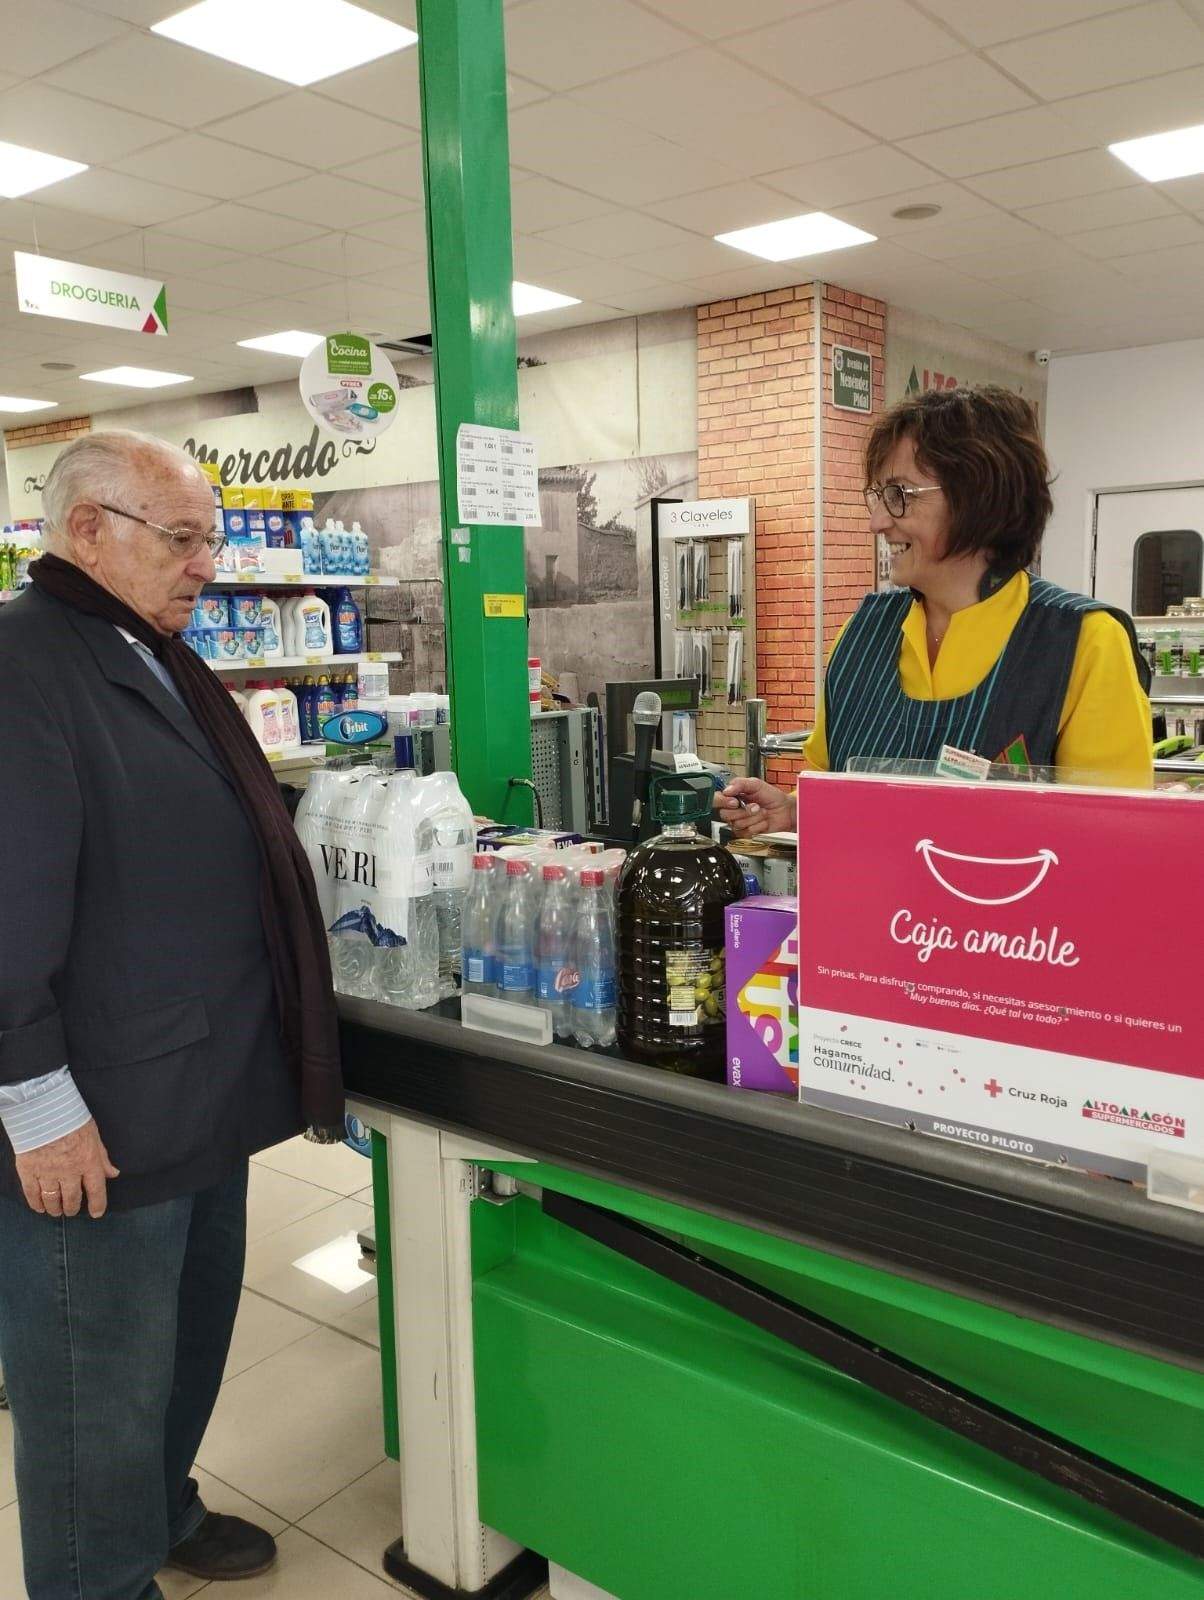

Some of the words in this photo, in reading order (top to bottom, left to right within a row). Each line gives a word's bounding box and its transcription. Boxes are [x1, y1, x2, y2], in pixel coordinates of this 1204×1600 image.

[50, 280, 141, 311] DROGUERIA
[331, 345, 368, 357] Cocina
[183, 424, 339, 486] Mercado
[671, 512, 677, 523] 3
[680, 509, 733, 523] Claveles
[318, 843, 377, 888] VERI
[890, 909, 958, 963] Caja
[963, 926, 1080, 967] amable
[817, 965, 830, 976] Sin
[831, 968, 857, 981] prisas.
[859, 972, 878, 984] Para
[917, 983, 971, 1000] comprando,
[973, 990, 981, 1000] si
[982, 992, 1026, 1008] necesitas
[1104, 1013, 1111, 1022] o
[1113, 1013, 1123, 1024] si
[1125, 1016, 1166, 1031] quieres
[1168, 1023, 1183, 1033] un
[929, 995, 960, 1009] buenos
[961, 1000, 982, 1013] días.
[984, 1004, 1007, 1016] ¿Qué
[1008, 1009, 1021, 1019] tal
[1022, 1012, 1034, 1022] va
[814, 1045, 863, 1062] Hagamos
[840, 1039, 862, 1049] CRECE
[732, 1057, 742, 1087] evax
[813, 1056, 895, 1082] comunidad.
[1008, 1087, 1037, 1101] Cruz
[1040, 1093, 1068, 1109] Roja
[1082, 1099, 1186, 1128] ALTOARAGÓN
[1091, 1111, 1175, 1135] SUPERMERCADOS
[933, 1122, 989, 1143] PROYECTO
[992, 1135, 1035, 1153] PILOTO
